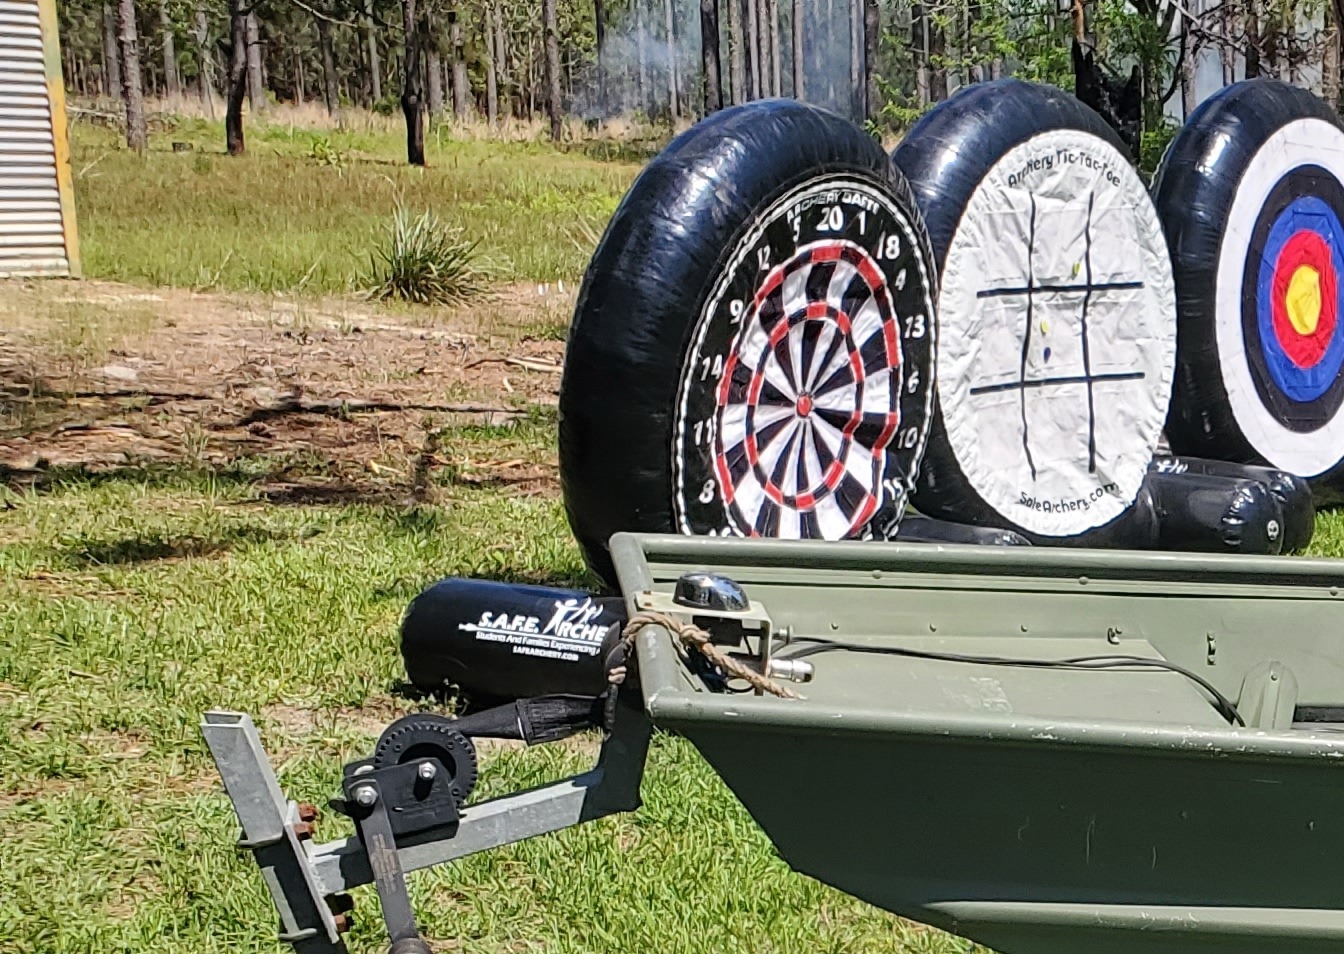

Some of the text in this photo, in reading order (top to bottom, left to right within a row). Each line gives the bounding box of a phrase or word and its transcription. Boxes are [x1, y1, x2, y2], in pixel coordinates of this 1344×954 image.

[1008, 149, 1121, 188] Archery Tic-Tac-Toe
[816, 206, 844, 231] 20
[857, 211, 867, 235] 1
[757, 244, 771, 271] 12
[877, 231, 900, 260] 18
[895, 268, 906, 291] 4
[730, 300, 743, 324] 9
[904, 315, 925, 340] 13
[701, 355, 722, 381] 14
[907, 372, 920, 393] 6
[694, 421, 714, 446] 11
[898, 427, 918, 449] 10
[700, 479, 715, 504] 8
[478, 598, 609, 643] S.A.F.E. ARCHE
